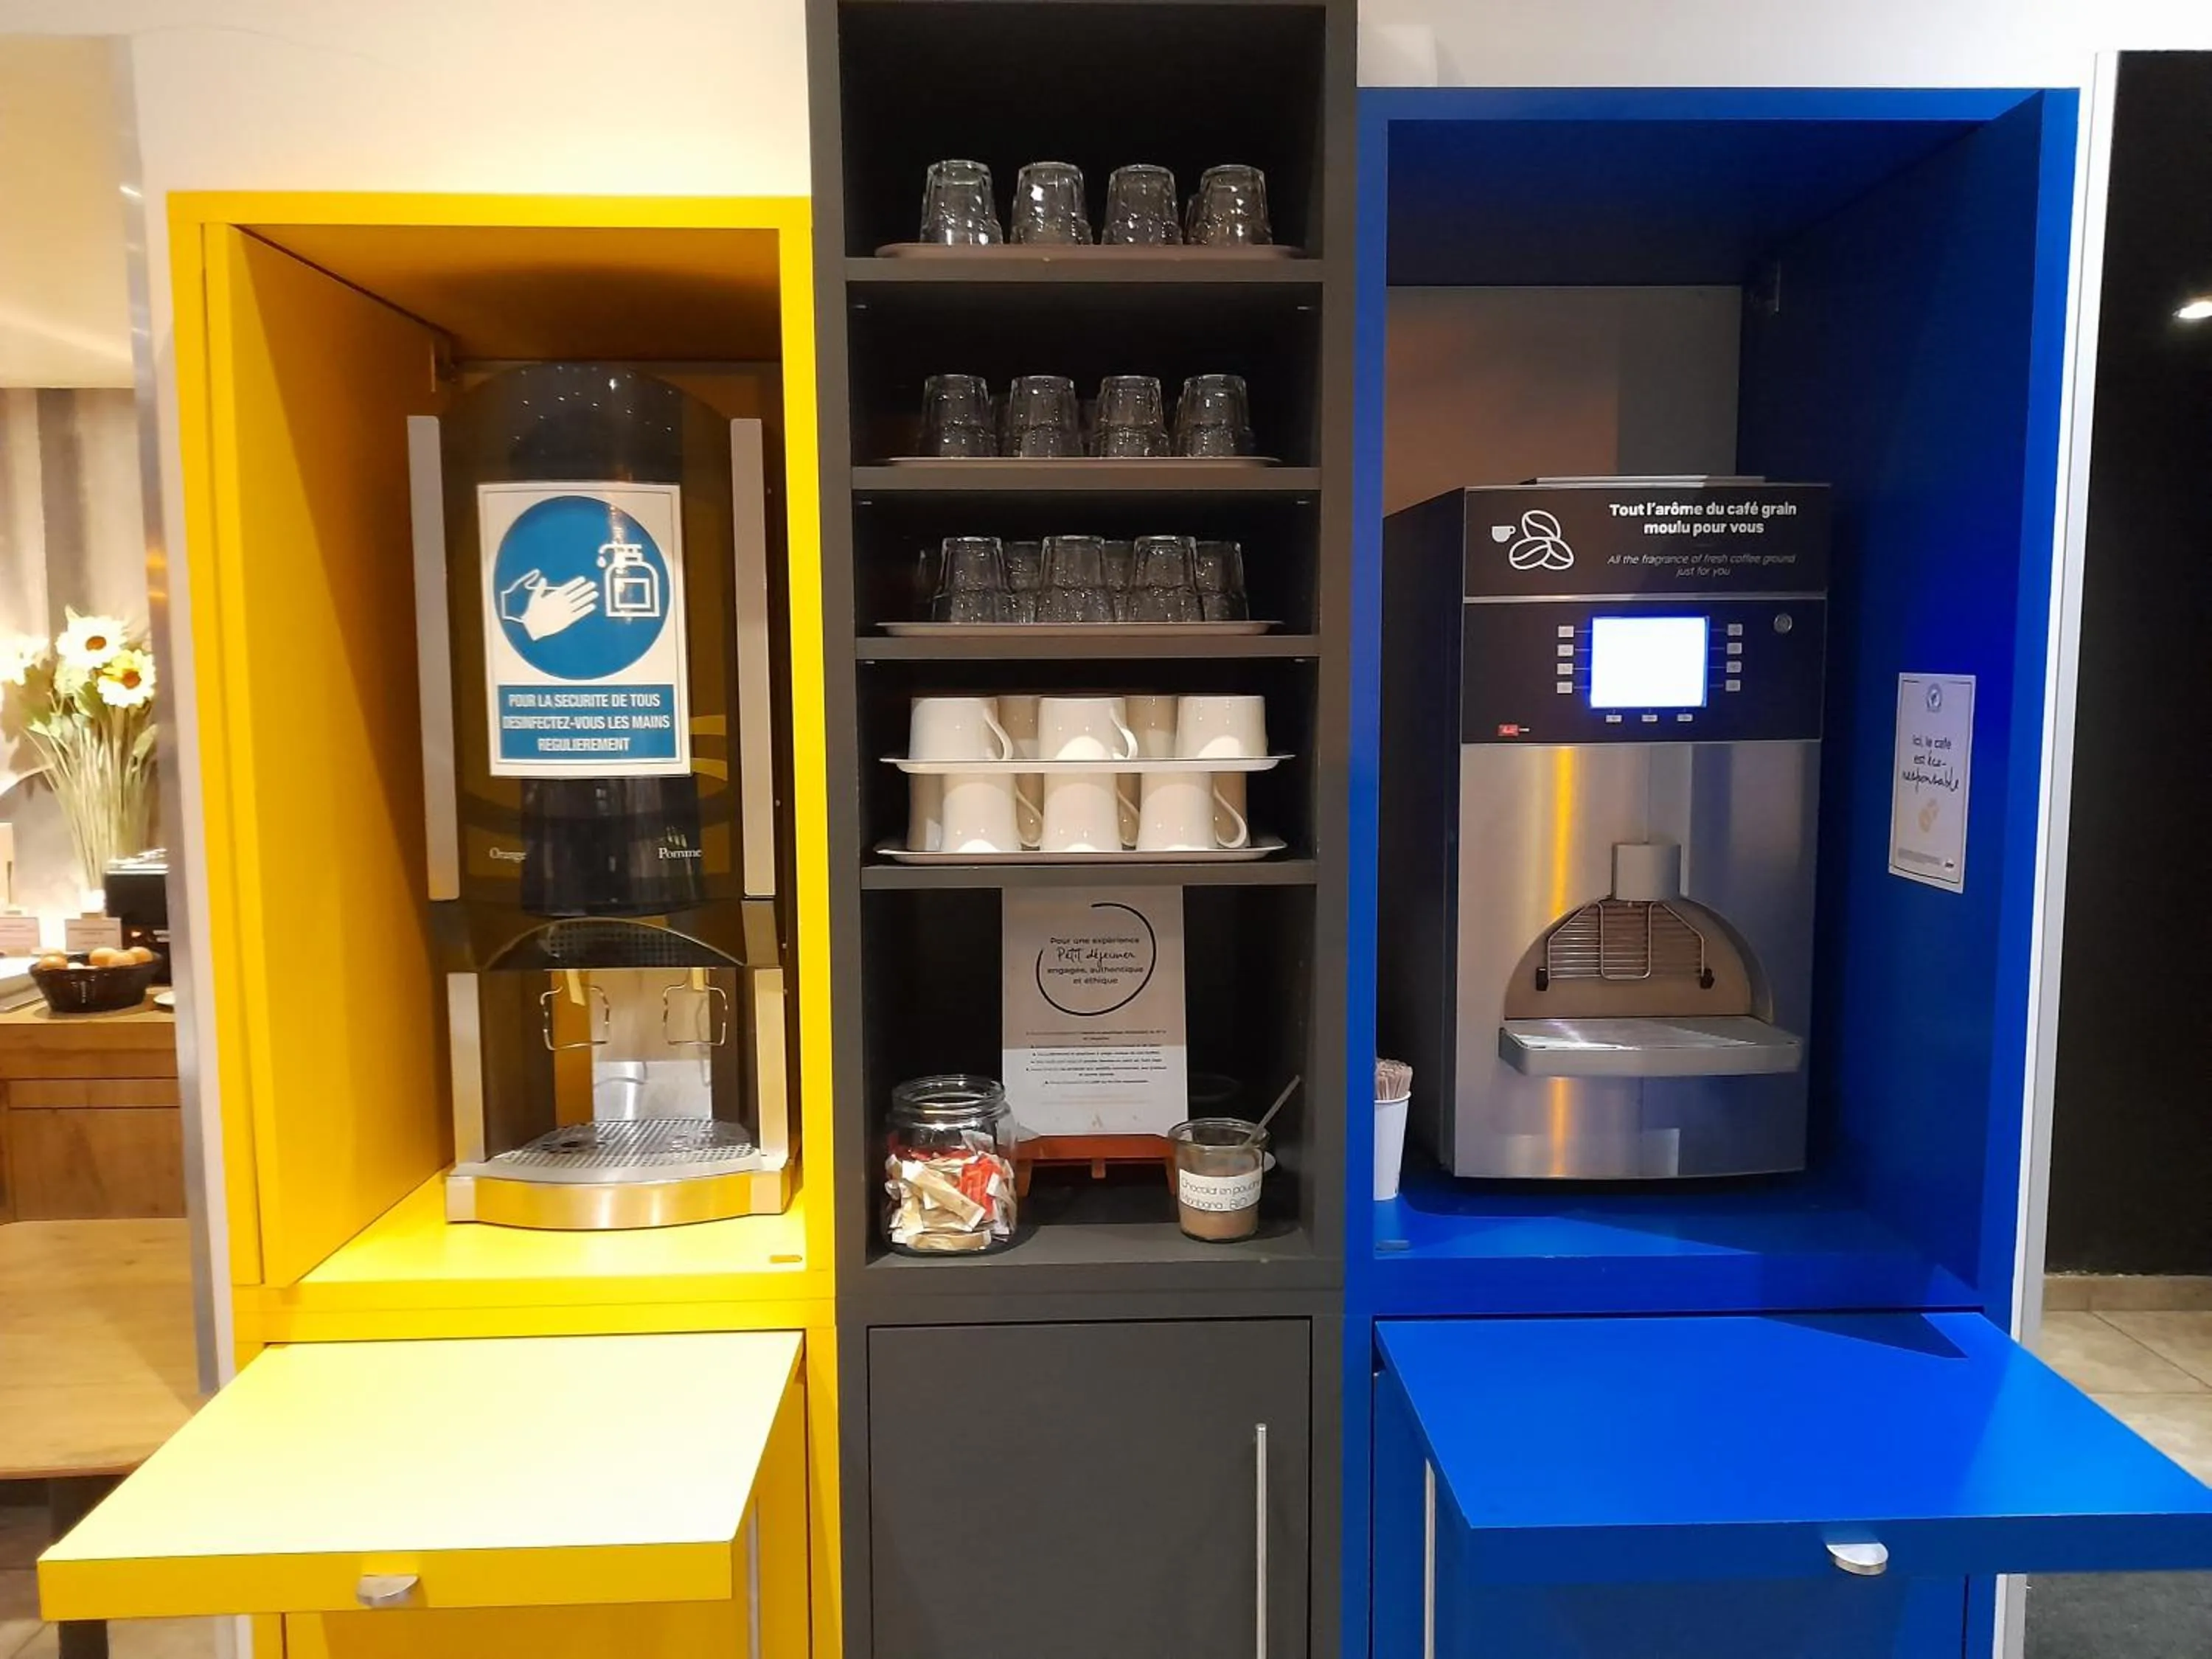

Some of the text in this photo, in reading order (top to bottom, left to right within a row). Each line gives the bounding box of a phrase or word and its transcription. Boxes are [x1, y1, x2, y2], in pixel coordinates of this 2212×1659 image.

[1609, 504, 1644, 516] Tout
[1706, 501, 1725, 515] du
[1727, 501, 1759, 515] café
[1761, 501, 1797, 519] grain
[1644, 521, 1764, 538] moulu pour vous
[1607, 554, 1796, 567] All the fragrance of fresh coffee ground
[1676, 567, 1731, 577] just for you
[509, 693, 661, 708] POUR LA SECURITE DE TOUS
[502, 714, 671, 729] DESINFECTEZ-VOUS LES MAINS
[538, 737, 630, 752] REGULIEREMENT
[1902, 767, 1959, 795] responsable
[658, 847, 703, 859] Pomme
